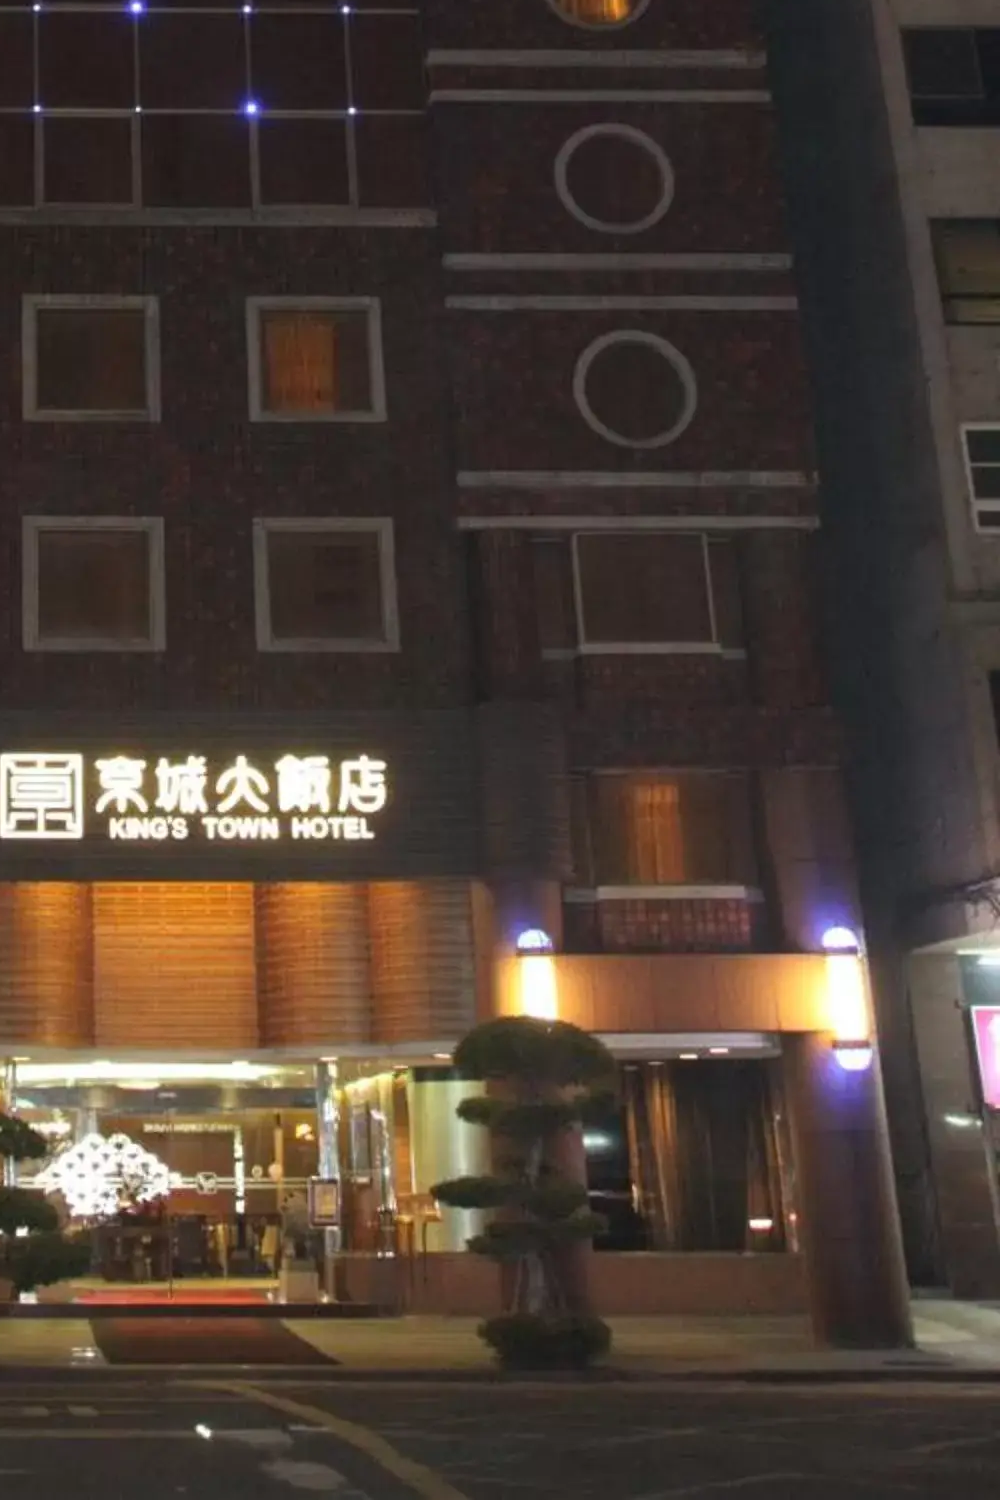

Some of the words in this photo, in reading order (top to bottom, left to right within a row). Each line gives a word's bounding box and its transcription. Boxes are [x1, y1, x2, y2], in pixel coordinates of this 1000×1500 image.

[94, 755, 388, 814] 京城大飯店
[109, 816, 189, 840] KING'S
[202, 816, 280, 840] TOWN
[291, 816, 375, 840] HOTEL
